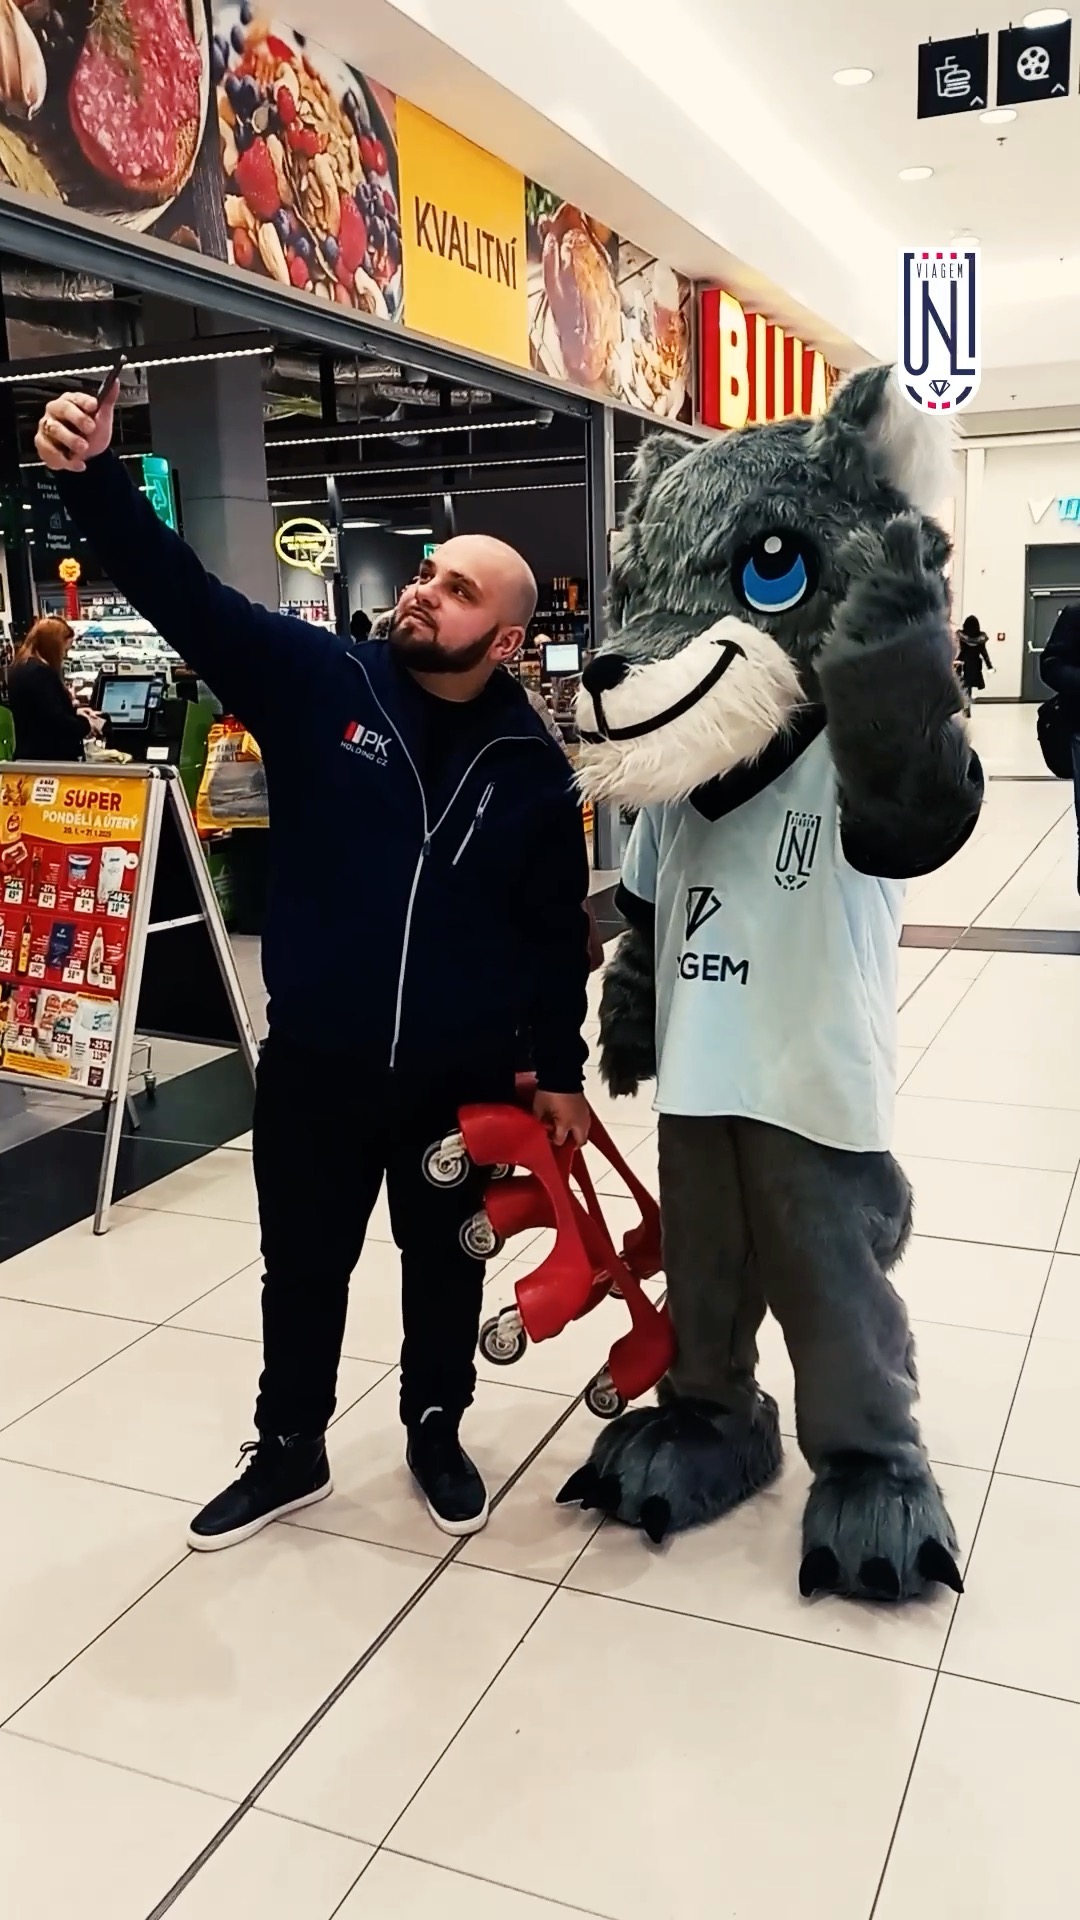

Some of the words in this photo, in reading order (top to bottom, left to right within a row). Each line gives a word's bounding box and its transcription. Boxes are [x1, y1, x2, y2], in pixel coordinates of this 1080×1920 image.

[414, 196, 518, 290] KVALITNÍ
[340, 741, 375, 761] HOLDING
[376, 757, 389, 767] CZ
[361, 730, 392, 757] PK
[64, 789, 122, 811] SUPER
[42, 809, 93, 827] PONDĚLÍ
[94, 817, 102, 828] A
[677, 952, 749, 985] GEM
